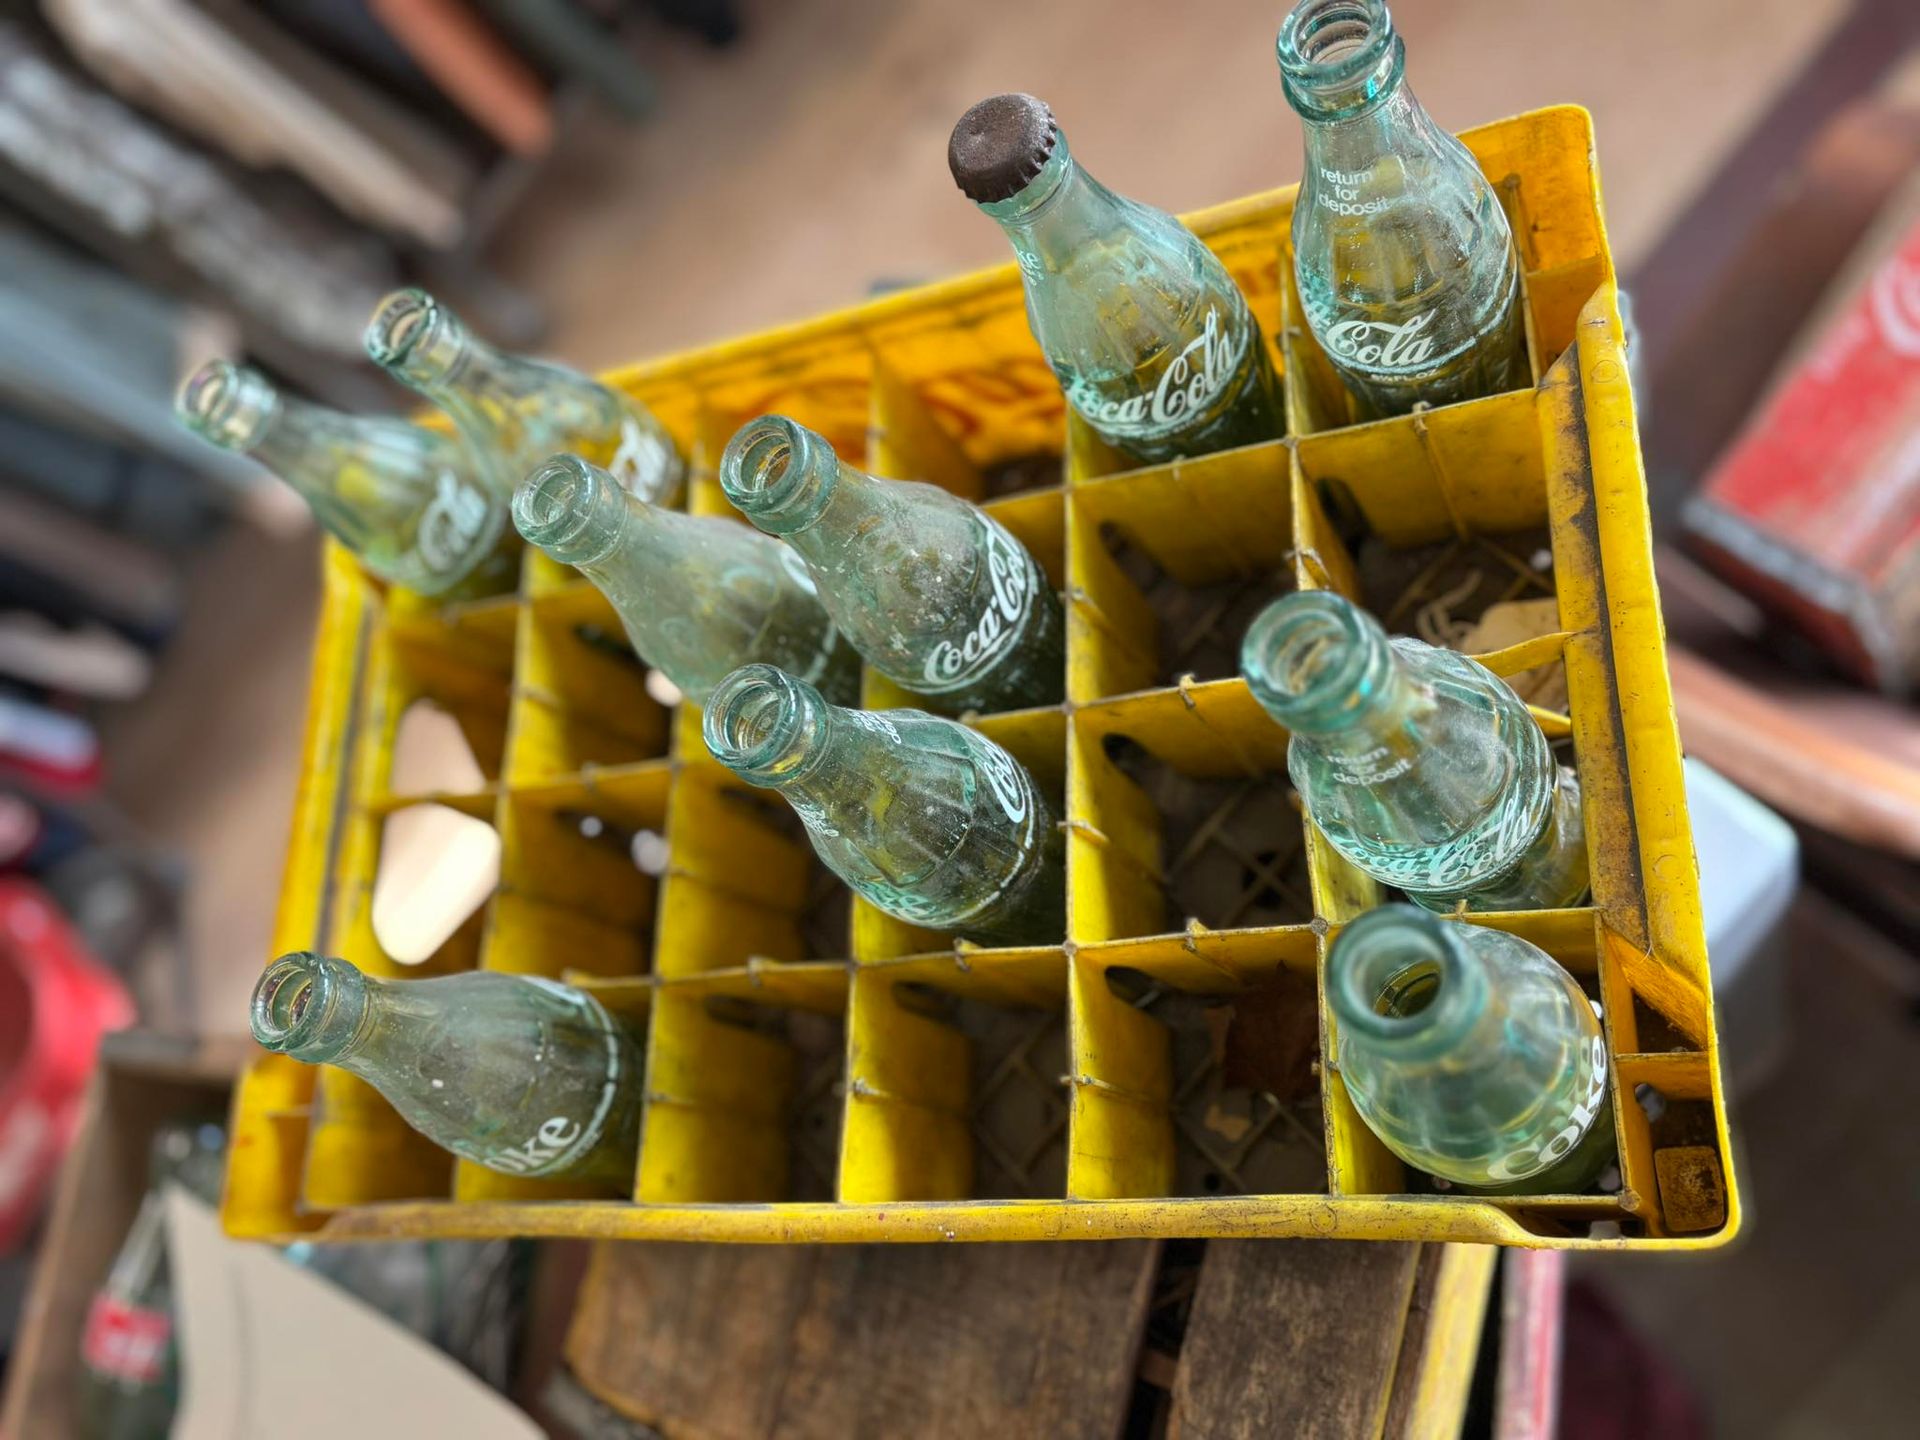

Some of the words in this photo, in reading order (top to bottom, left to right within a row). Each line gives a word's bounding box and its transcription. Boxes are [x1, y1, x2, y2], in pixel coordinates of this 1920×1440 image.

[1320, 167, 1375, 185] return
[1335, 185, 1360, 201] for
[1318, 193, 1391, 216] deposit
[1332, 759, 1413, 787] deposit
